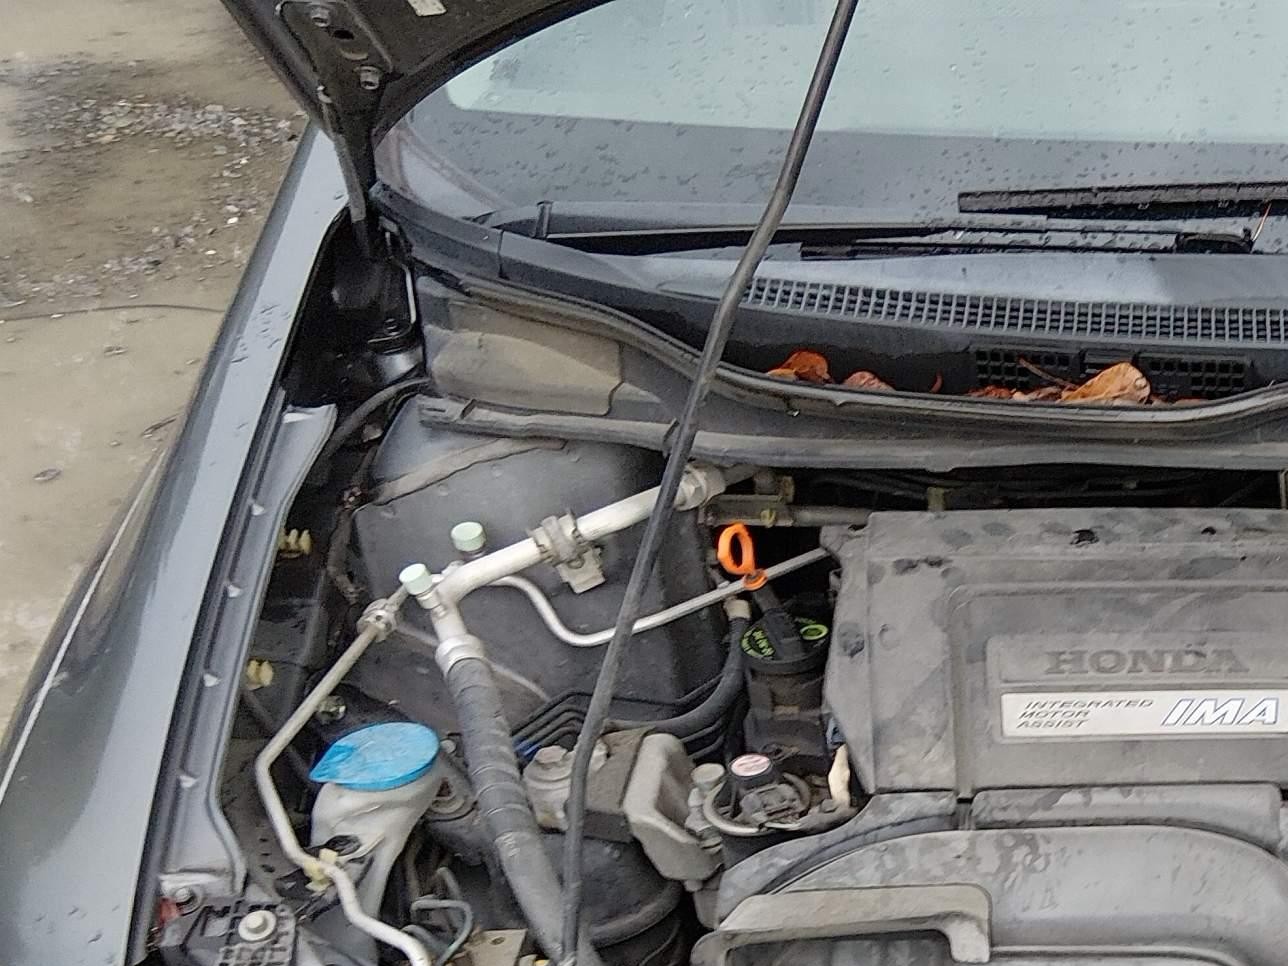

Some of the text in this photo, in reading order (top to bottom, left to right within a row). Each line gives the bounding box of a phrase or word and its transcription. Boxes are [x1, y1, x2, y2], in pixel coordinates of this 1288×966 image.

[1045, 649, 1250, 675] HONDA
[1025, 699, 1154, 709] INTEGRATED
[1019, 710, 1090, 719] MOTOR
[1160, 697, 1279, 726] IMA
[1016, 719, 1090, 728] ASSIST
